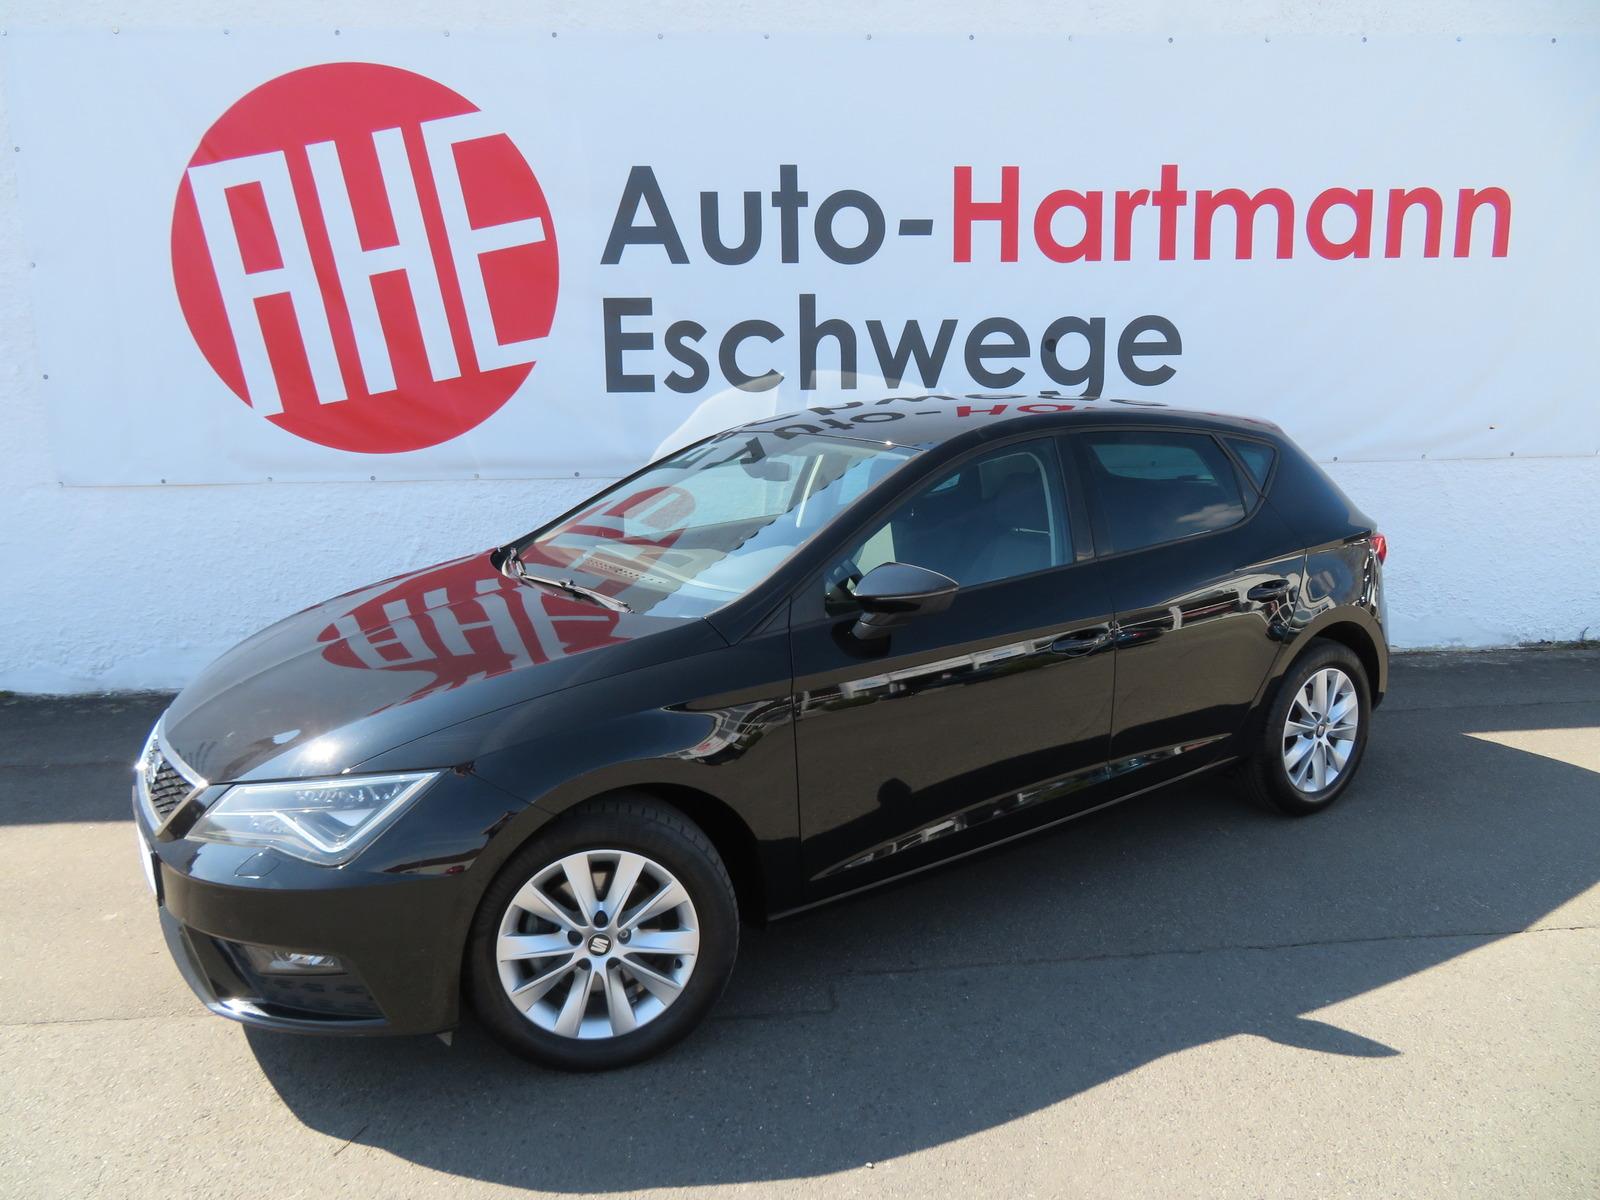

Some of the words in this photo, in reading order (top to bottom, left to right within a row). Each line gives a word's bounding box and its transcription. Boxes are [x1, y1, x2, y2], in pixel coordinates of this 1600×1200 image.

[187, 110, 551, 417] AHE
[600, 164, 1511, 266] Auto-Hartmann
[602, 293, 1183, 401] Eschwege
